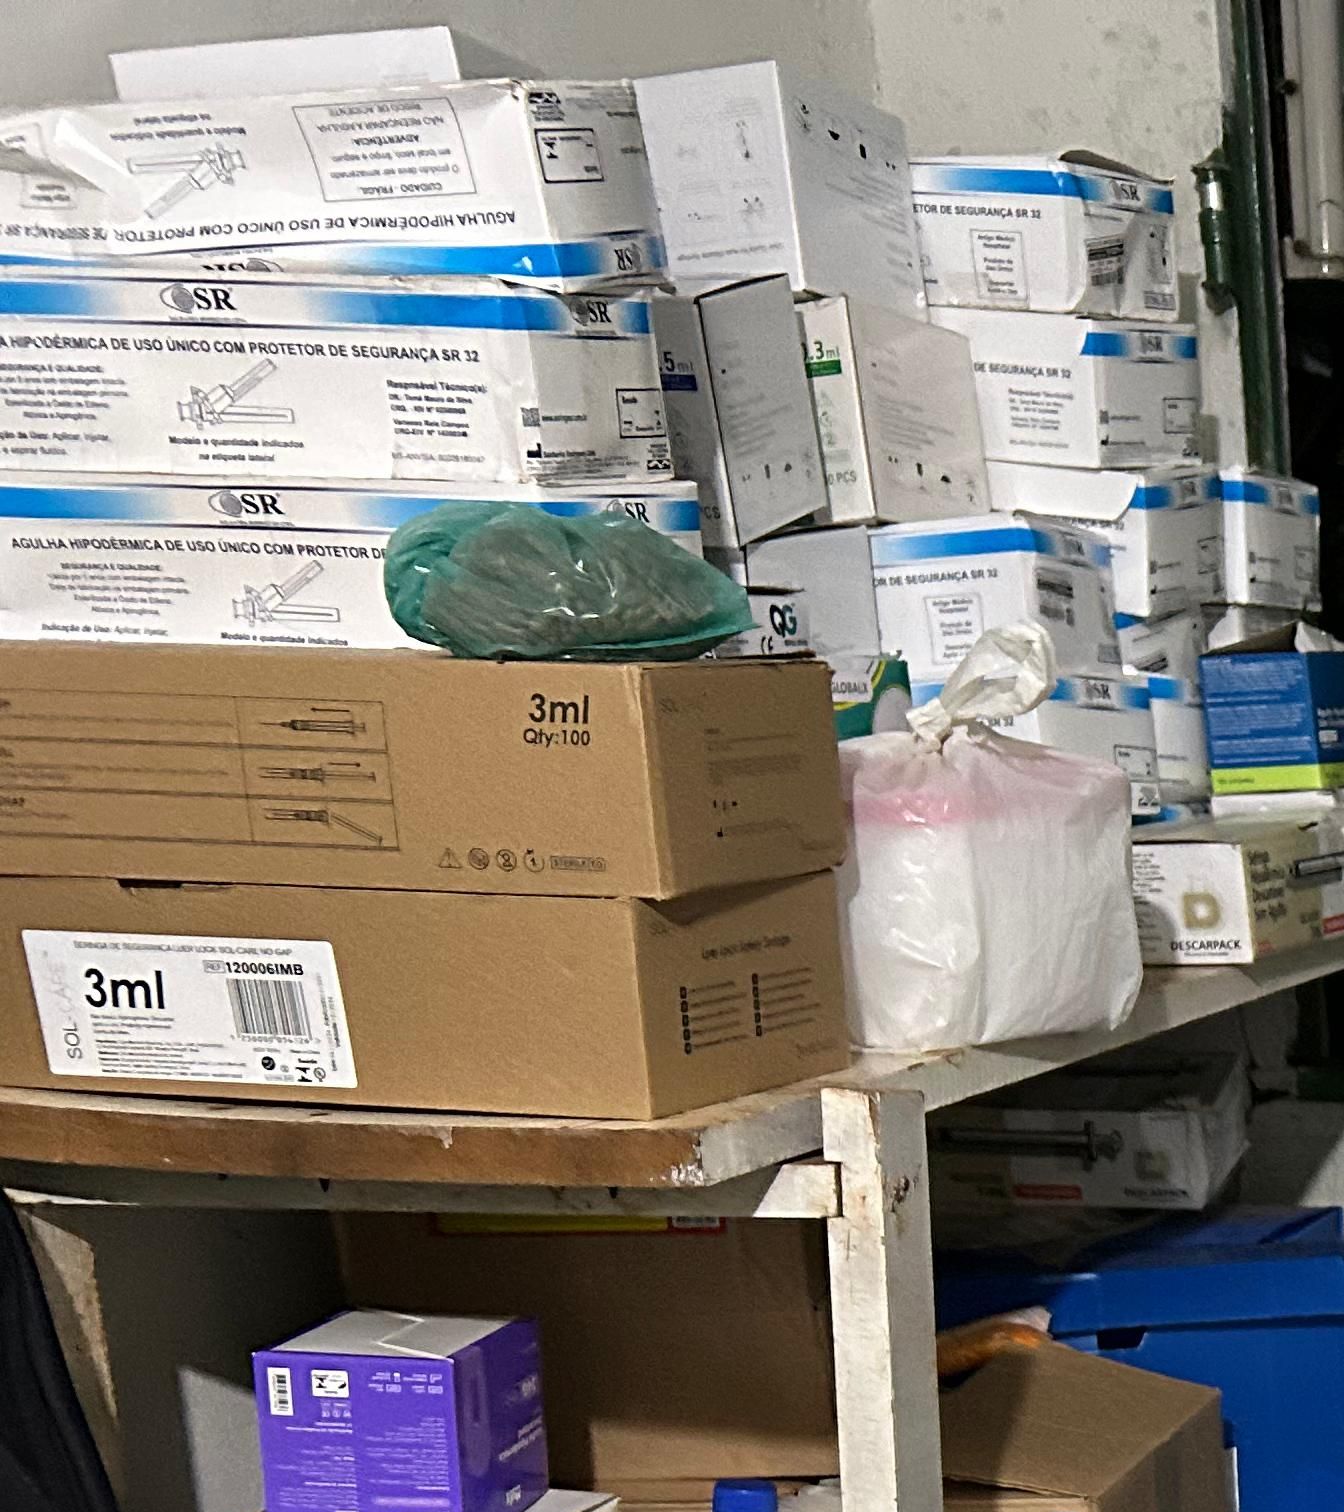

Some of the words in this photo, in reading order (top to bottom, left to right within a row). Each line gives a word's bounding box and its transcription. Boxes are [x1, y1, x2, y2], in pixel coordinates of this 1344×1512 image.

[456, 209, 516, 229] AGULHA
[939, 204, 953, 215] DE
[955, 205, 1014, 219] SEGURANÇA
[237, 220, 285, 237] ÚNICO
[288, 218, 321, 233] USO
[324, 216, 345, 230] DE
[349, 213, 455, 230] HIPODÉRMICA
[113, 226, 196, 244] PROTETOR
[199, 223, 233, 240] COM
[589, 300, 613, 324] SR
[11, 333, 109, 351] HIPODÉRMICA
[111, 338, 131, 351] DE
[134, 339, 163, 352] USO
[166, 335, 210, 353] ÚNICO
[212, 341, 246, 354] COM
[250, 342, 326, 359] PROTETOR
[328, 344, 349, 359] DE
[351, 345, 439, 363] SEGURANÇA
[442, 348, 461, 362] SR
[463, 350, 480, 363] 32
[989, 362, 1044, 378] SEGURANÇA
[11, 537, 67, 551] AGULHA
[69, 536, 164, 552] HIPODÉRMICA
[165, 539, 185, 552] DE
[186, 539, 216, 553] USO
[218, 537, 260, 555] ÚNICO
[263, 543, 295, 556] COM
[296, 543, 370, 560] PROTETOR
[905, 570, 969, 586] SEGURANÇA
[528, 692, 590, 726] 3ml
[523, 728, 591, 749] Qty:100
[225, 961, 305, 977] 120006IMB
[84, 968, 166, 1010] 3ml
